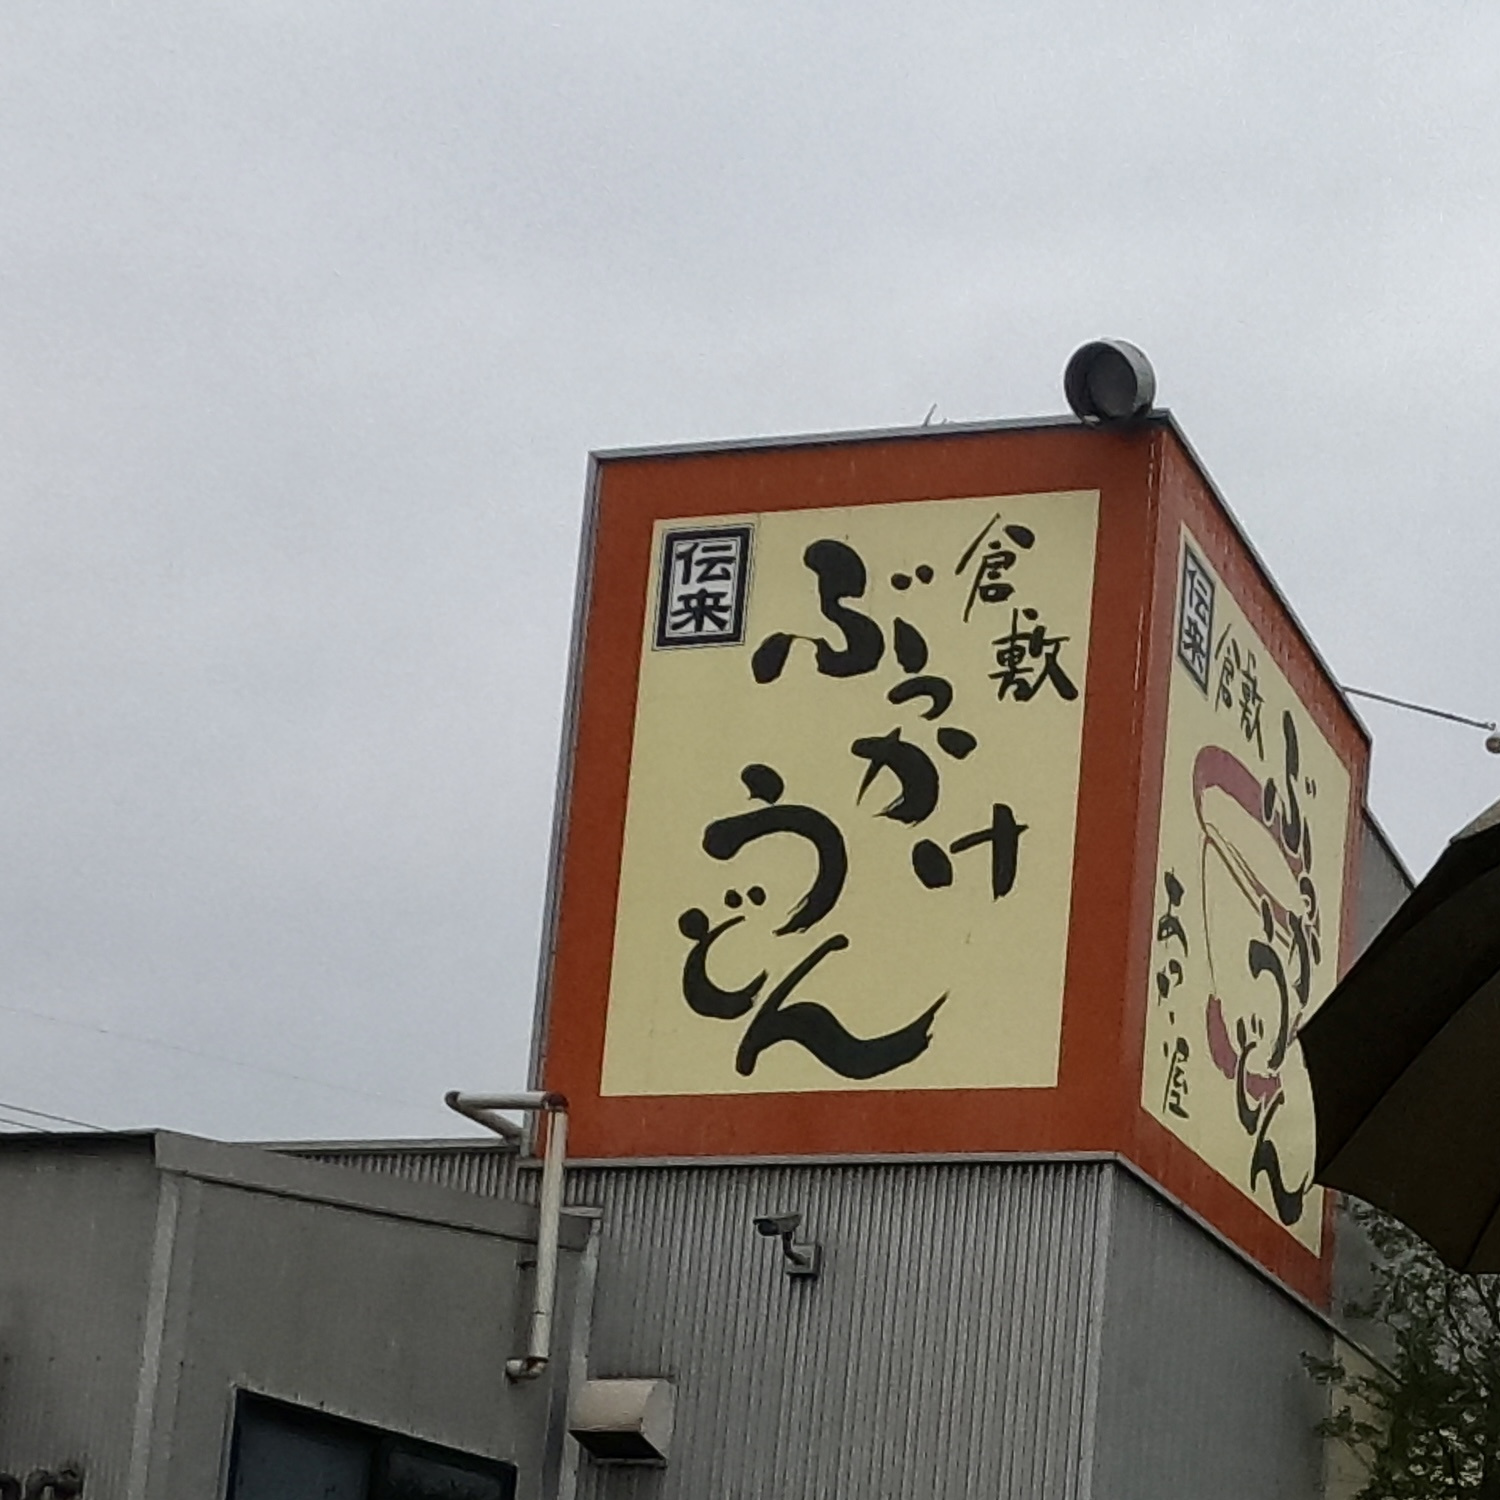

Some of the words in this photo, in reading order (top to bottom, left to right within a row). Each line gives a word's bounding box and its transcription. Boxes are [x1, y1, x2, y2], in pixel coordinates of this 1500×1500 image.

[672, 540, 738, 634] 伝来
[955, 513, 1079, 702] 倉敷
[1183, 569, 1210, 674] 伝来
[1215, 622, 1264, 762] 倉敷
[751, 538, 1028, 900] ぶっかけ
[678, 763, 950, 1080] うどん
[1264, 709, 1321, 1008] ぶっか
[1236, 898, 1310, 1226] うどん
